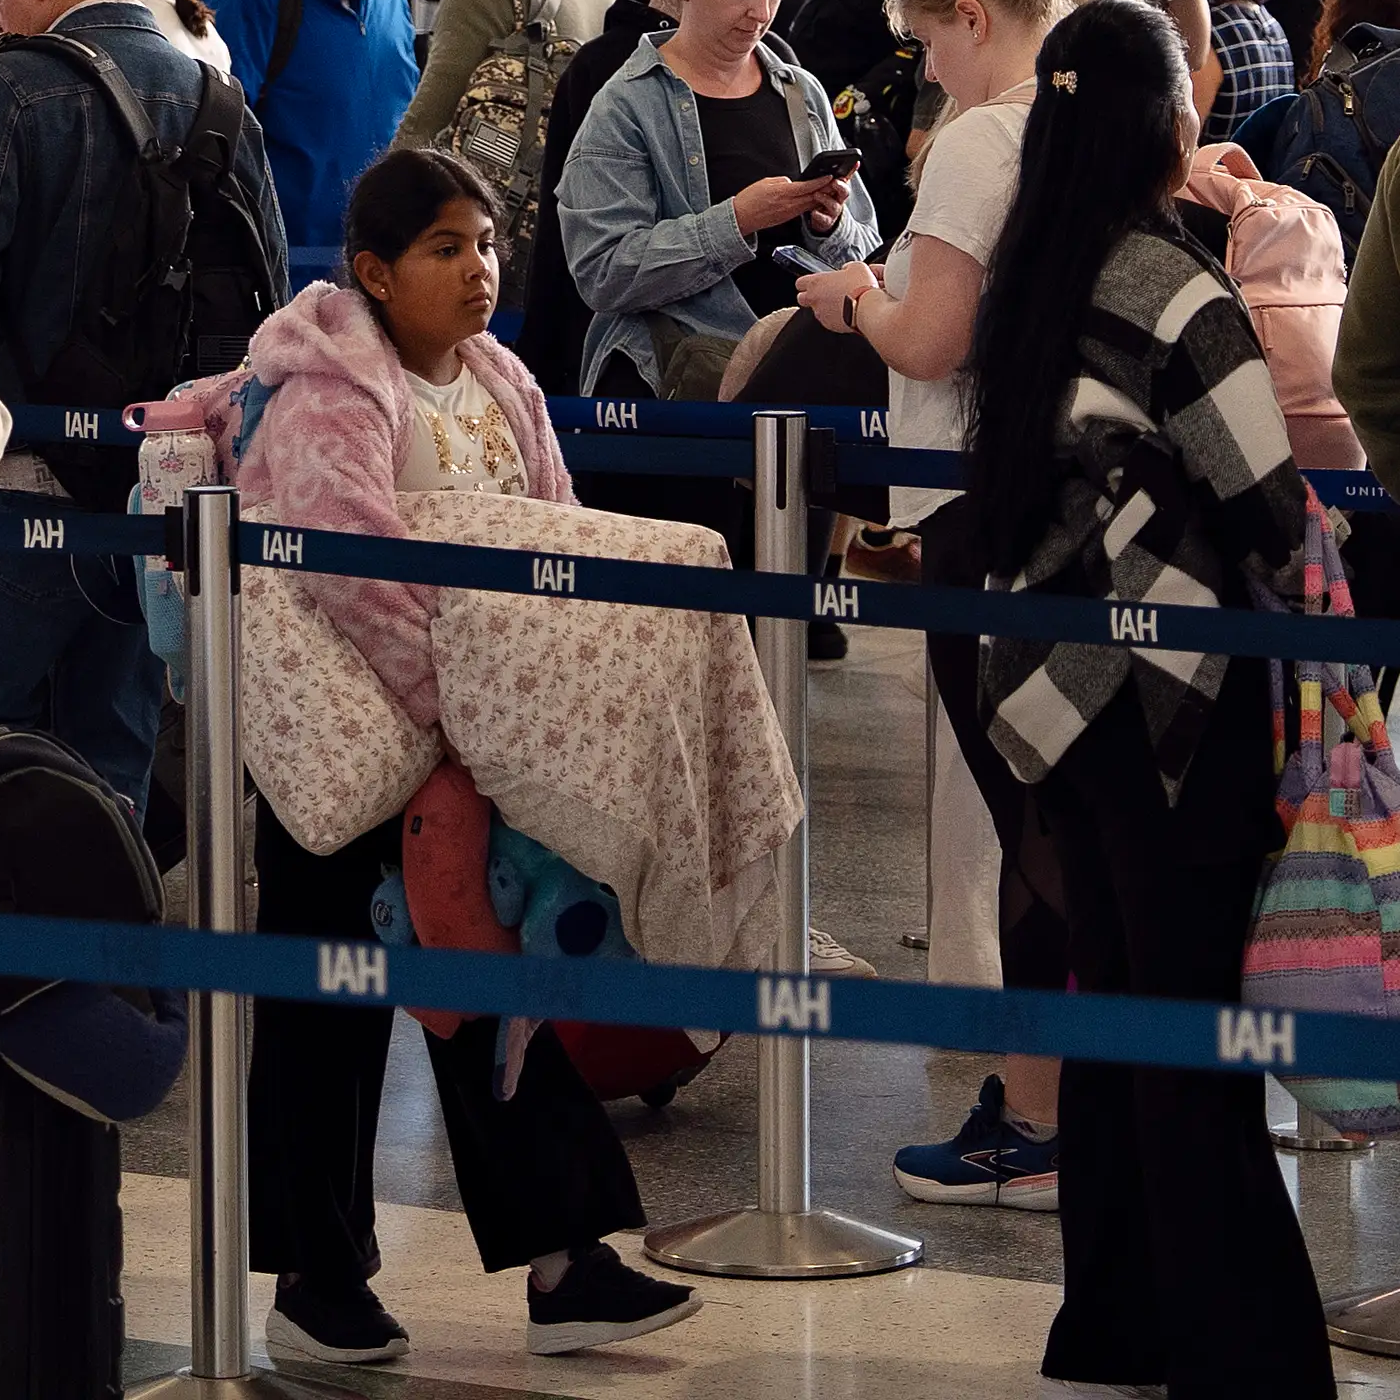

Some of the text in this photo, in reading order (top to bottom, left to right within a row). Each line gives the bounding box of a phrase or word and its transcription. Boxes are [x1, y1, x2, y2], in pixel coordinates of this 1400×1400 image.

[65, 411, 98, 440] IAH
[597, 402, 637, 429] IAH
[24, 518, 64, 549] IAH
[263, 530, 303, 563] IAH
[533, 558, 575, 592] IAH
[815, 583, 858, 618] IAH
[1111, 607, 1158, 642] IAH
[319, 944, 387, 996] IAH
[758, 977, 830, 1031] IAH
[1218, 1009, 1294, 1064] IAH
